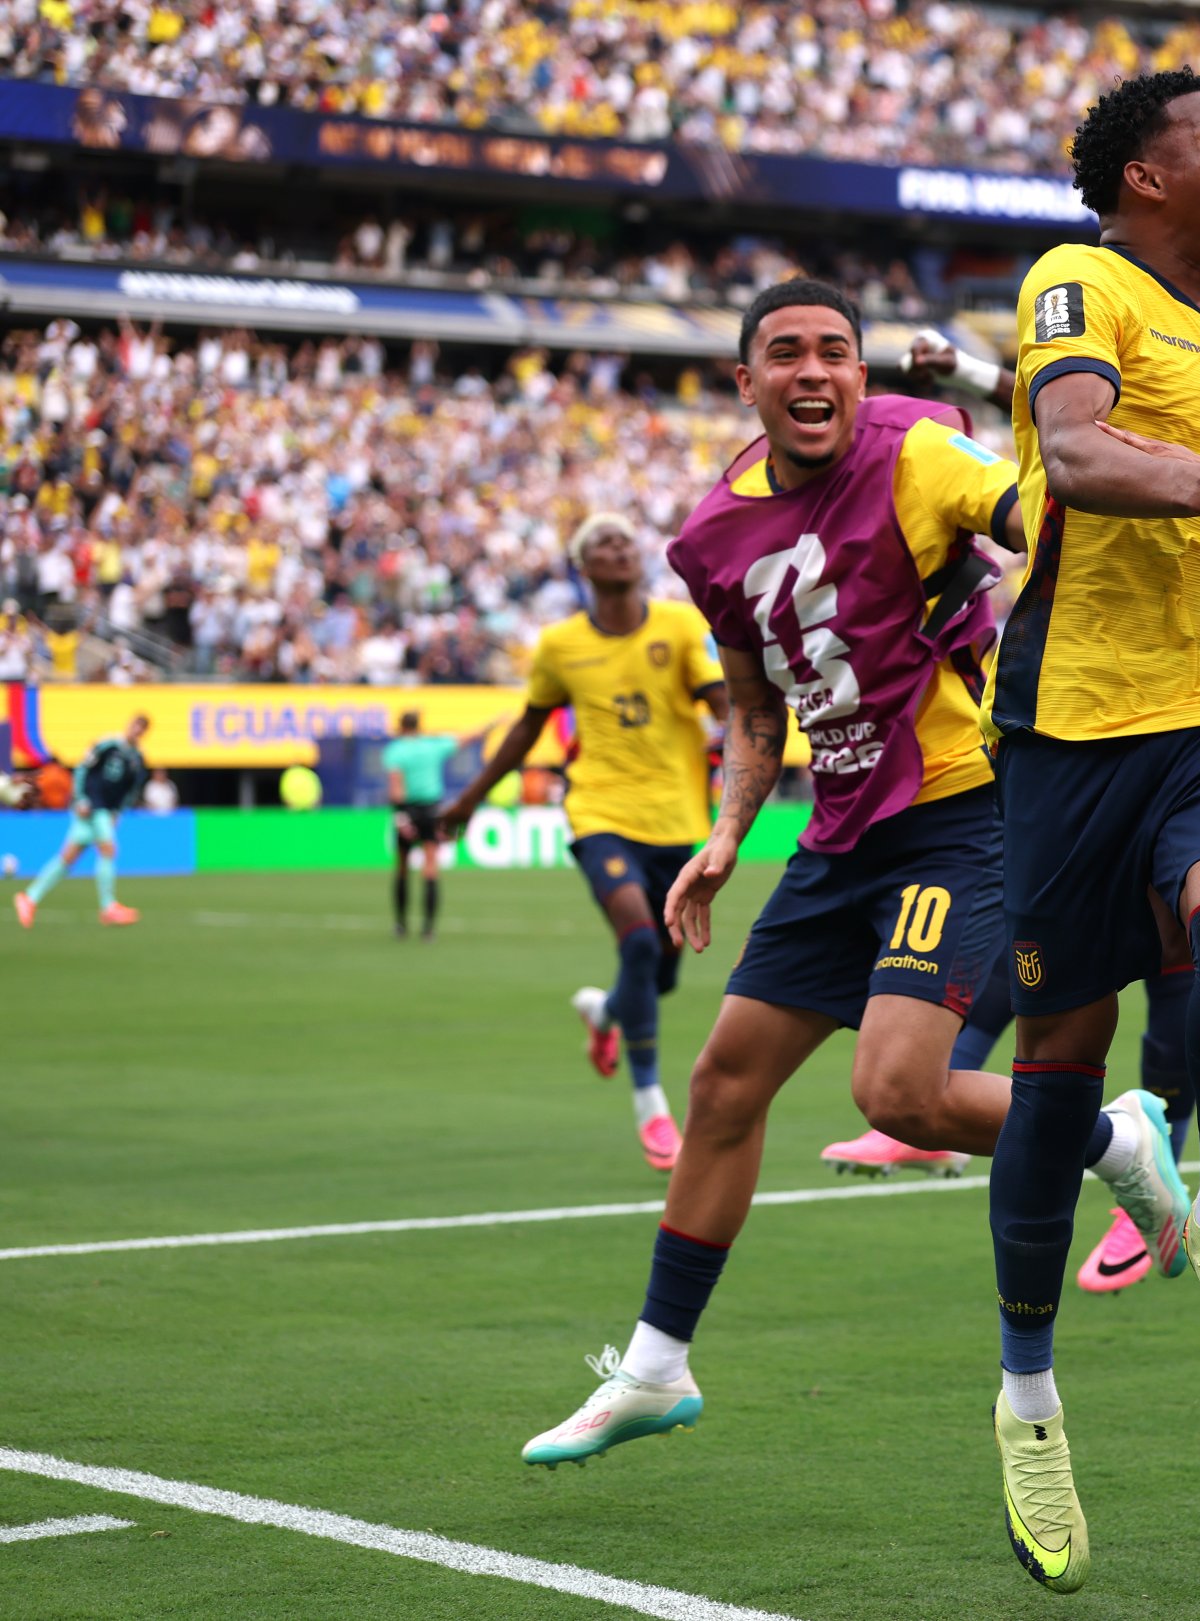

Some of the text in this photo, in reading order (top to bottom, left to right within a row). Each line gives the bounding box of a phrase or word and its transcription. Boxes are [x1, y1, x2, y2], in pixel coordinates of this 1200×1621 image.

[191, 704, 390, 743] ECUADOR
[845, 722, 877, 742] CUP
[889, 884, 952, 953] 10
